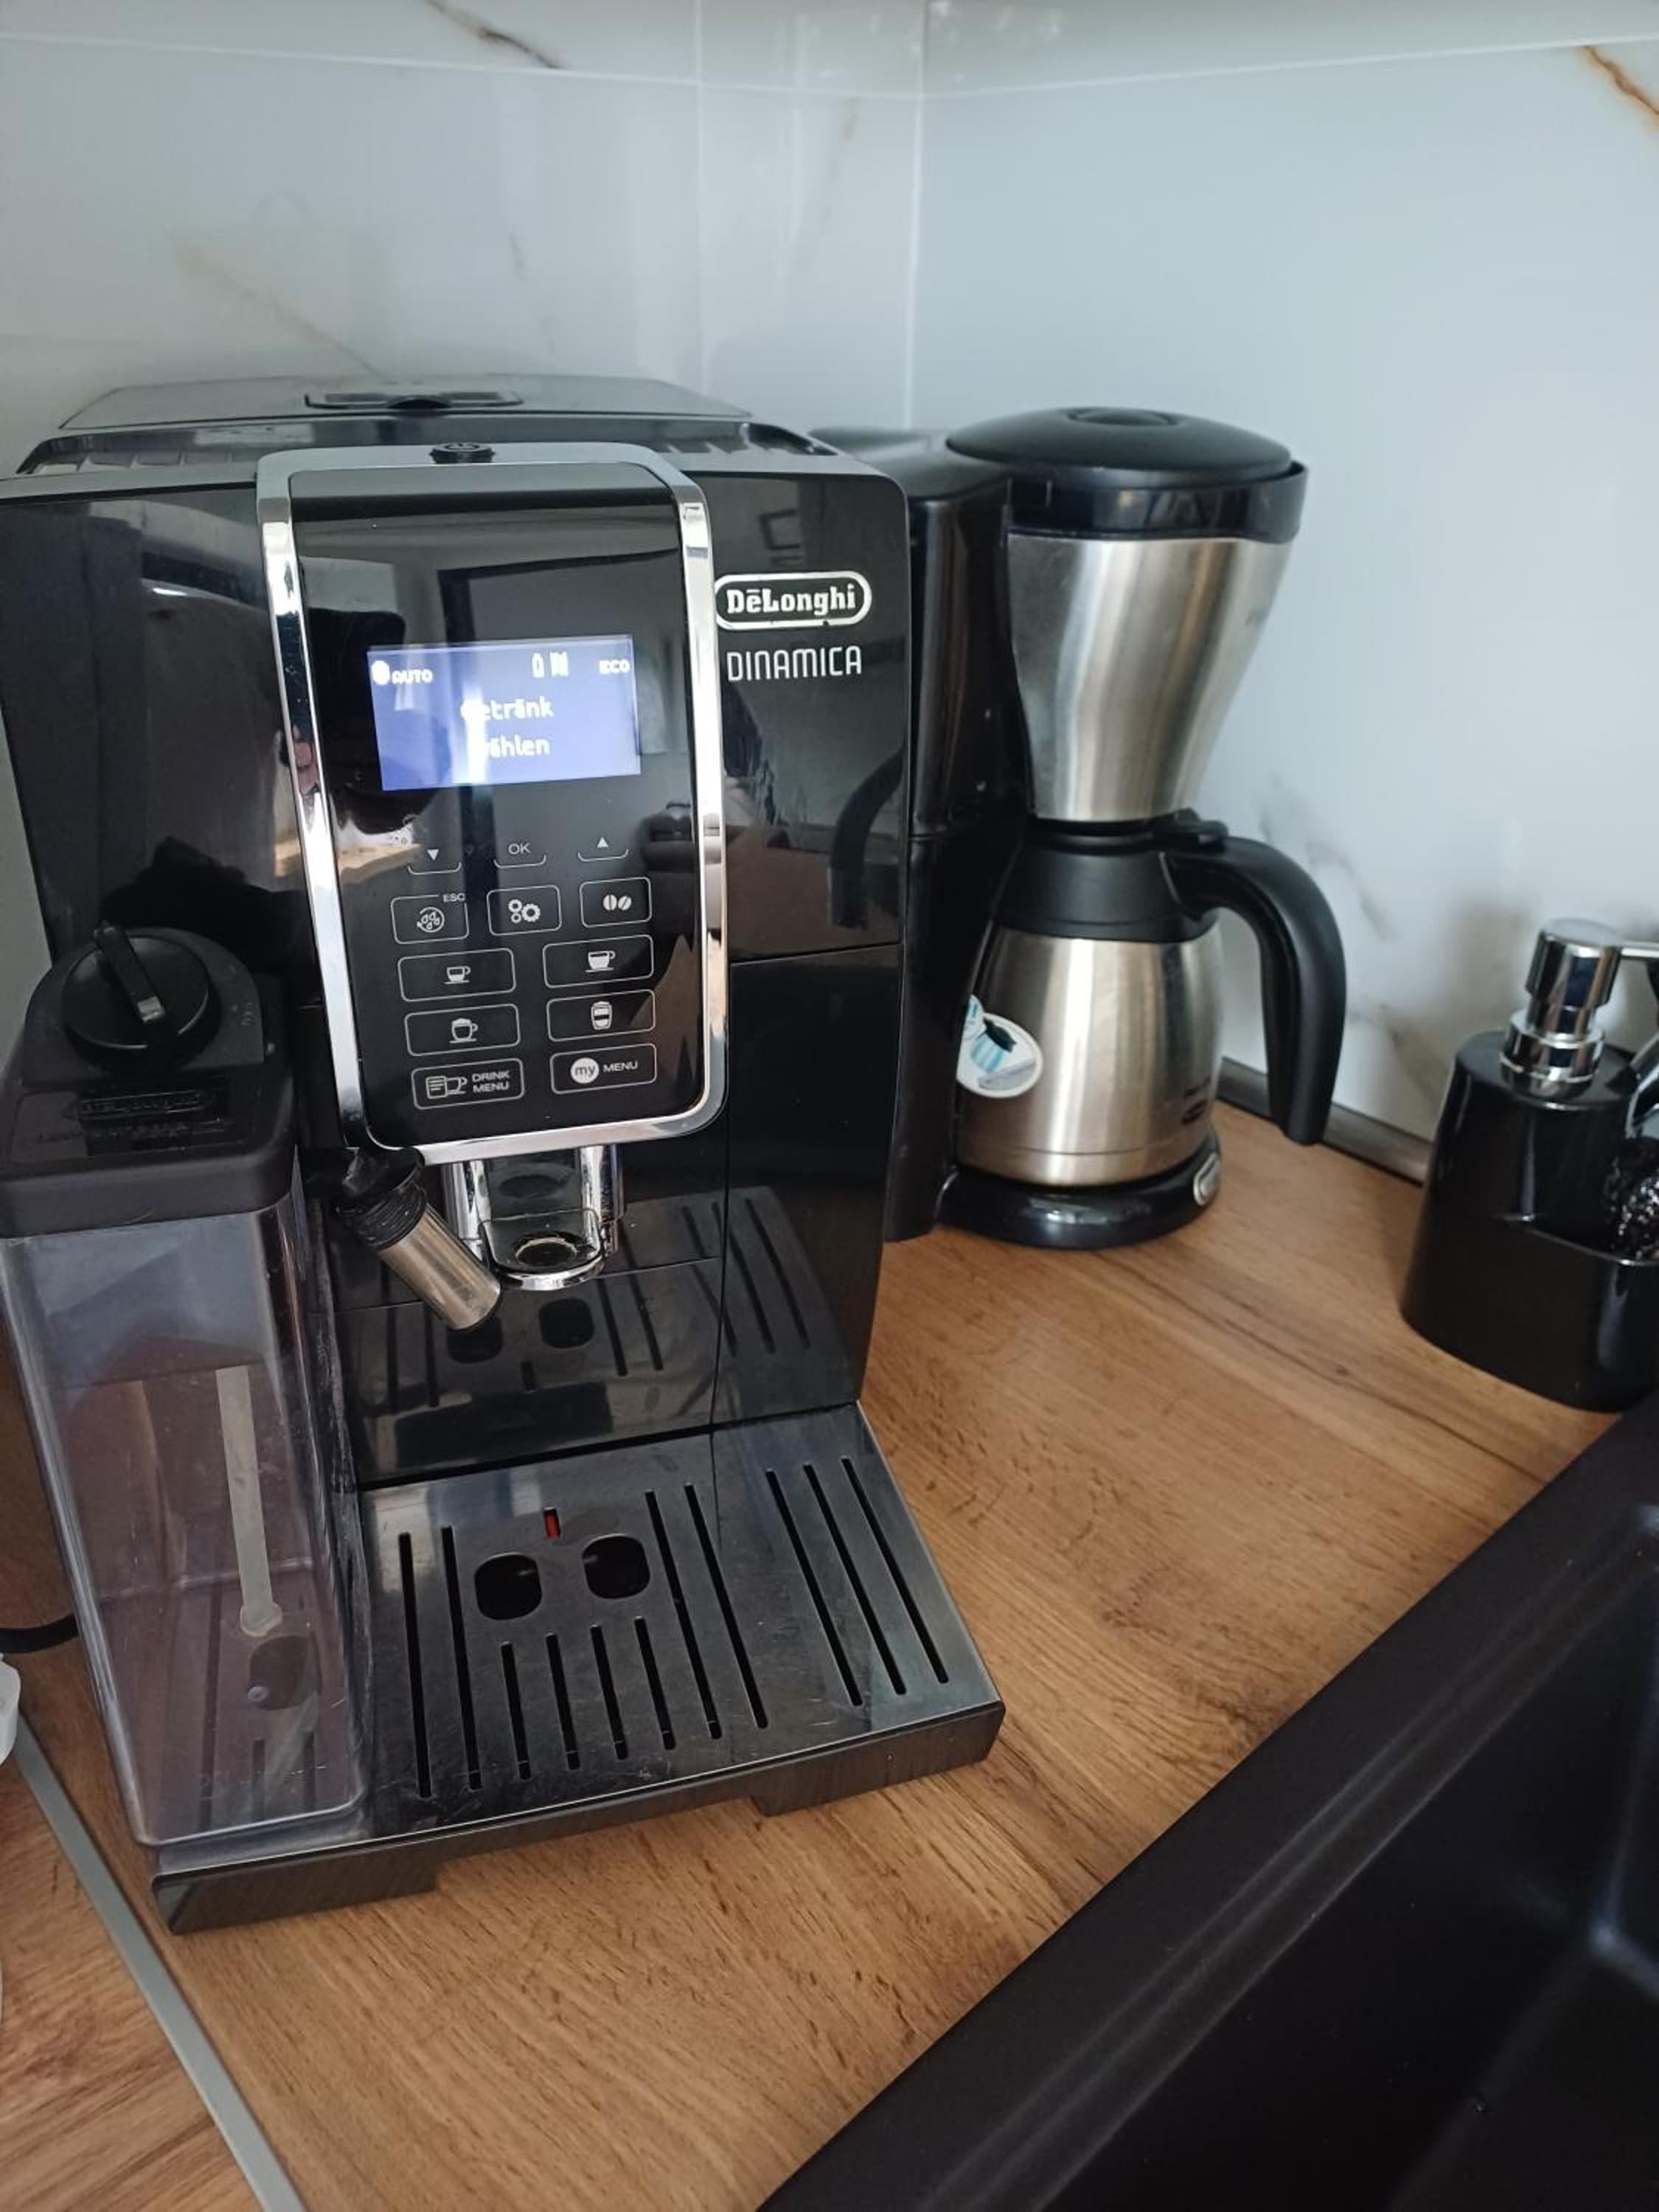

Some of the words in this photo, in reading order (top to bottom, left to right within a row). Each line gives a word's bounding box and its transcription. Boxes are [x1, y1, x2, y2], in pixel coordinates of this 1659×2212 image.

[726, 645, 862, 682] DINAMICA
[392, 669, 434, 684] AUTO
[507, 842, 531, 855] OK
[442, 892, 466, 903] ESC
[574, 1066, 597, 1080] my
[602, 1060, 639, 1074] MENU
[472, 1071, 510, 1084] DRINK
[472, 1081, 510, 1094] MENU
